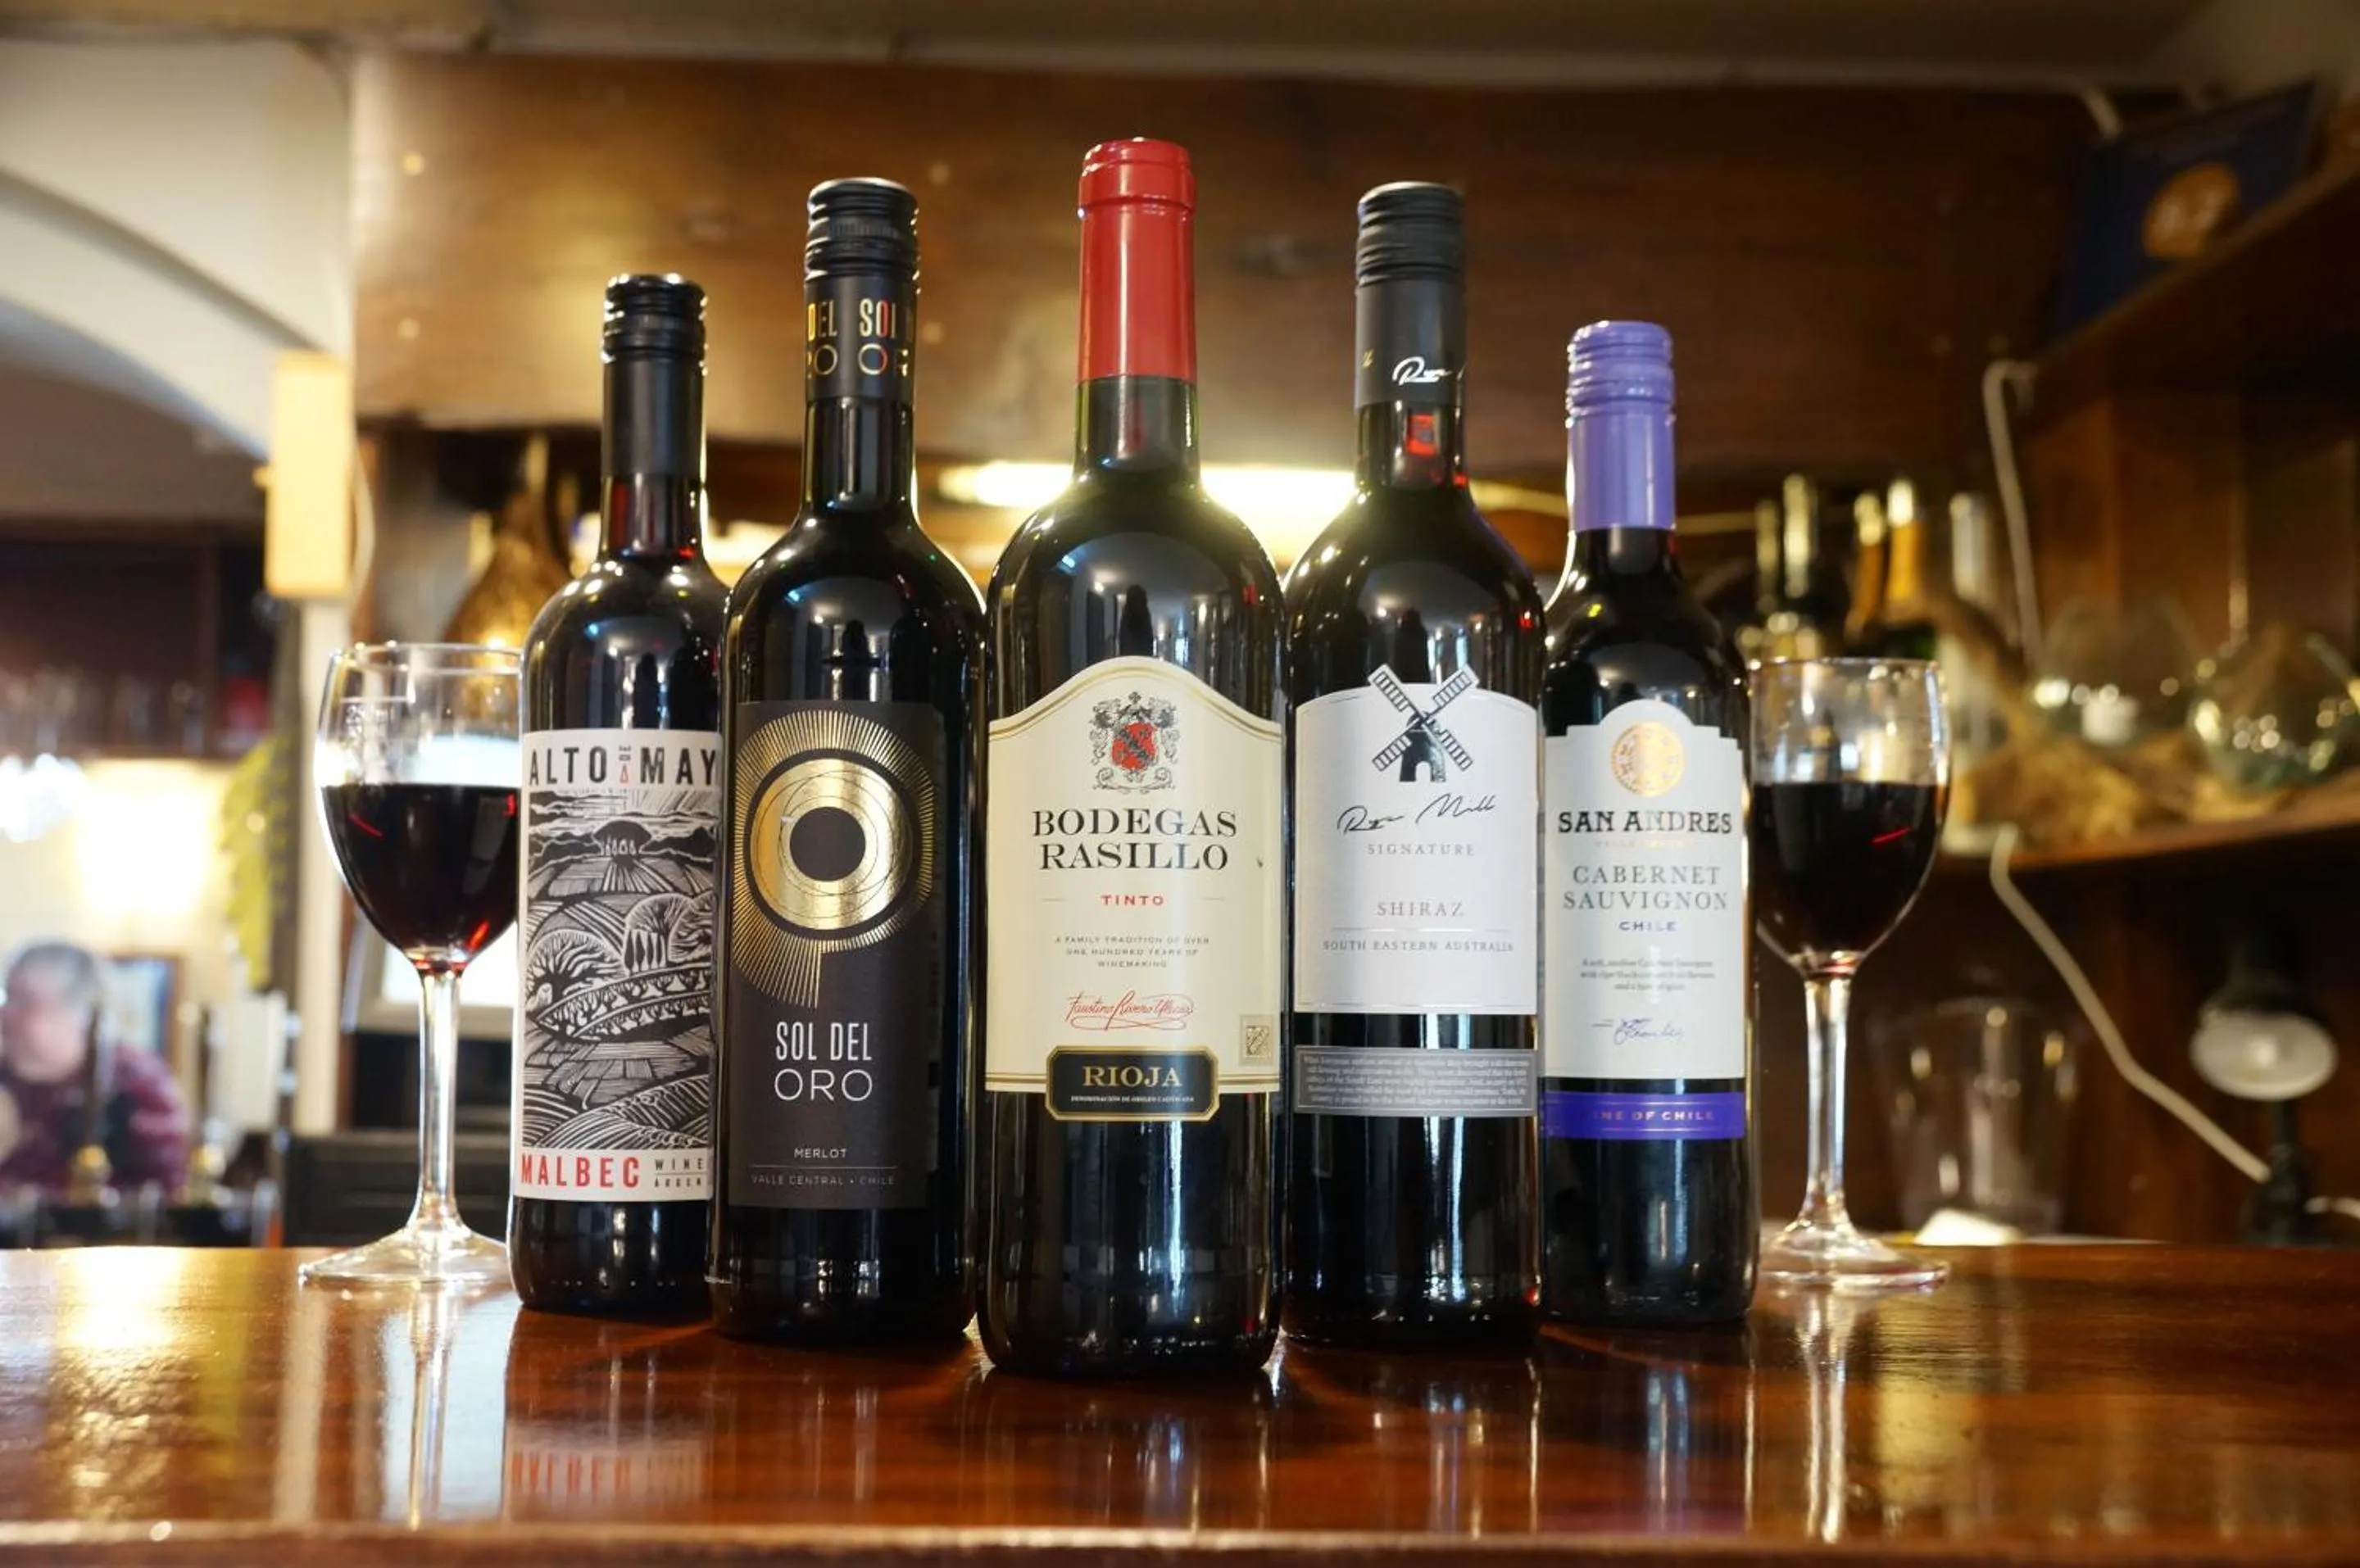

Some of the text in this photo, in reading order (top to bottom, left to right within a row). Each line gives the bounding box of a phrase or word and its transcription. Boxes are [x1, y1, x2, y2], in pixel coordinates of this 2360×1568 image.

[529, 746, 607, 786] ALTO
[639, 746, 717, 786] MAY
[1032, 808, 1237, 837] BODEGAS
[1558, 810, 1733, 834] SAN ANDRES
[1039, 842, 1229, 870] RASILLO
[1368, 844, 1476, 857] SIGNATURE
[1573, 865, 1722, 886] CABERNET
[1101, 895, 1165, 907] TINTO
[1377, 901, 1464, 917] SHIRAZ
[1562, 890, 1728, 911] SAUVIGNON
[1618, 921, 1677, 932] CHILE
[1064, 936, 1101, 944] FAMILY
[1105, 936, 1163, 944] TRADITION
[1323, 940, 1514, 953] SOUTH EASTERN AUSTRALIA
[1098, 960, 1167, 968] WINEMAKING
[775, 1021, 873, 1061] SOL DEL
[774, 1067, 873, 1102] ORO
[1082, 1065, 1183, 1088] RIOJA
[1632, 1111, 1655, 1121] OF
[1661, 1111, 1715, 1121] CHILE
[793, 1148, 848, 1159] MERLOT
[520, 1153, 705, 1189] MALBEC WINE
[751, 1175, 895, 1186] VALLE CENTRAL CHILE
